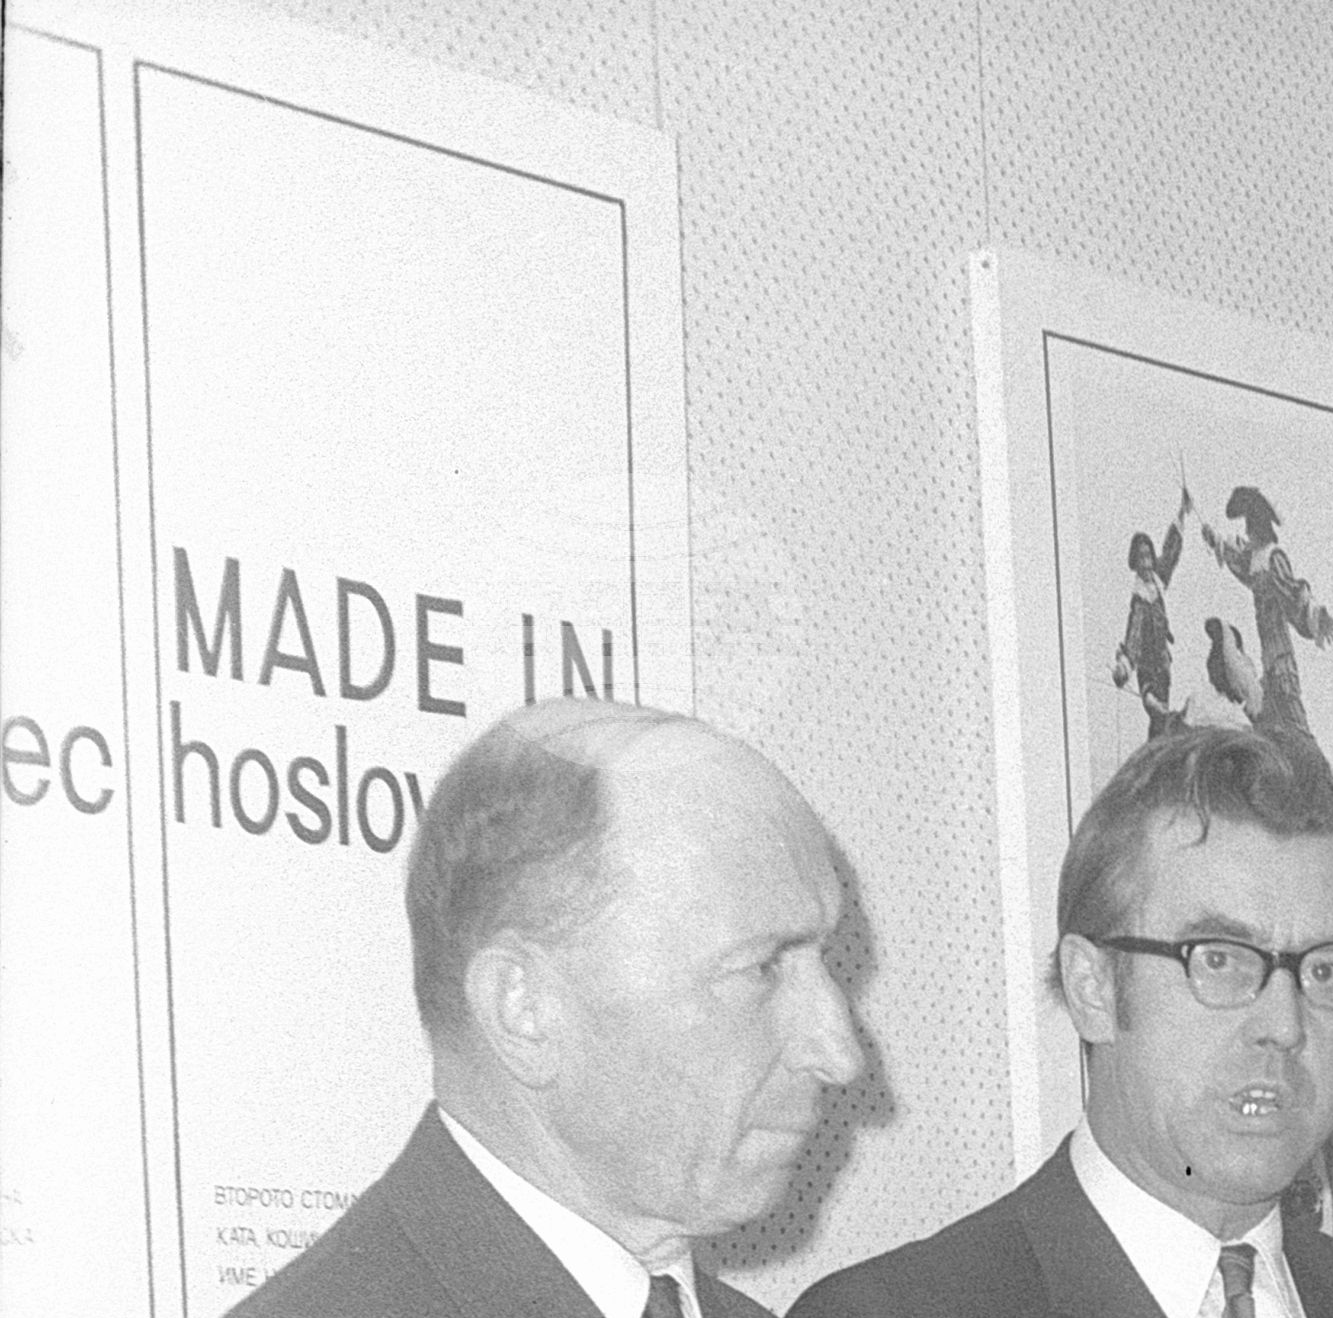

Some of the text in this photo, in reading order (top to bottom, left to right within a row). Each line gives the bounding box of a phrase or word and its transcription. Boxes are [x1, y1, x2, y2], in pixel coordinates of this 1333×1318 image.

[172, 545, 468, 719] MADE
[521, 612, 614, 706] IN
[1, 714, 116, 816] ec
[213, 1185, 294, 1209] ВТОРОТО
